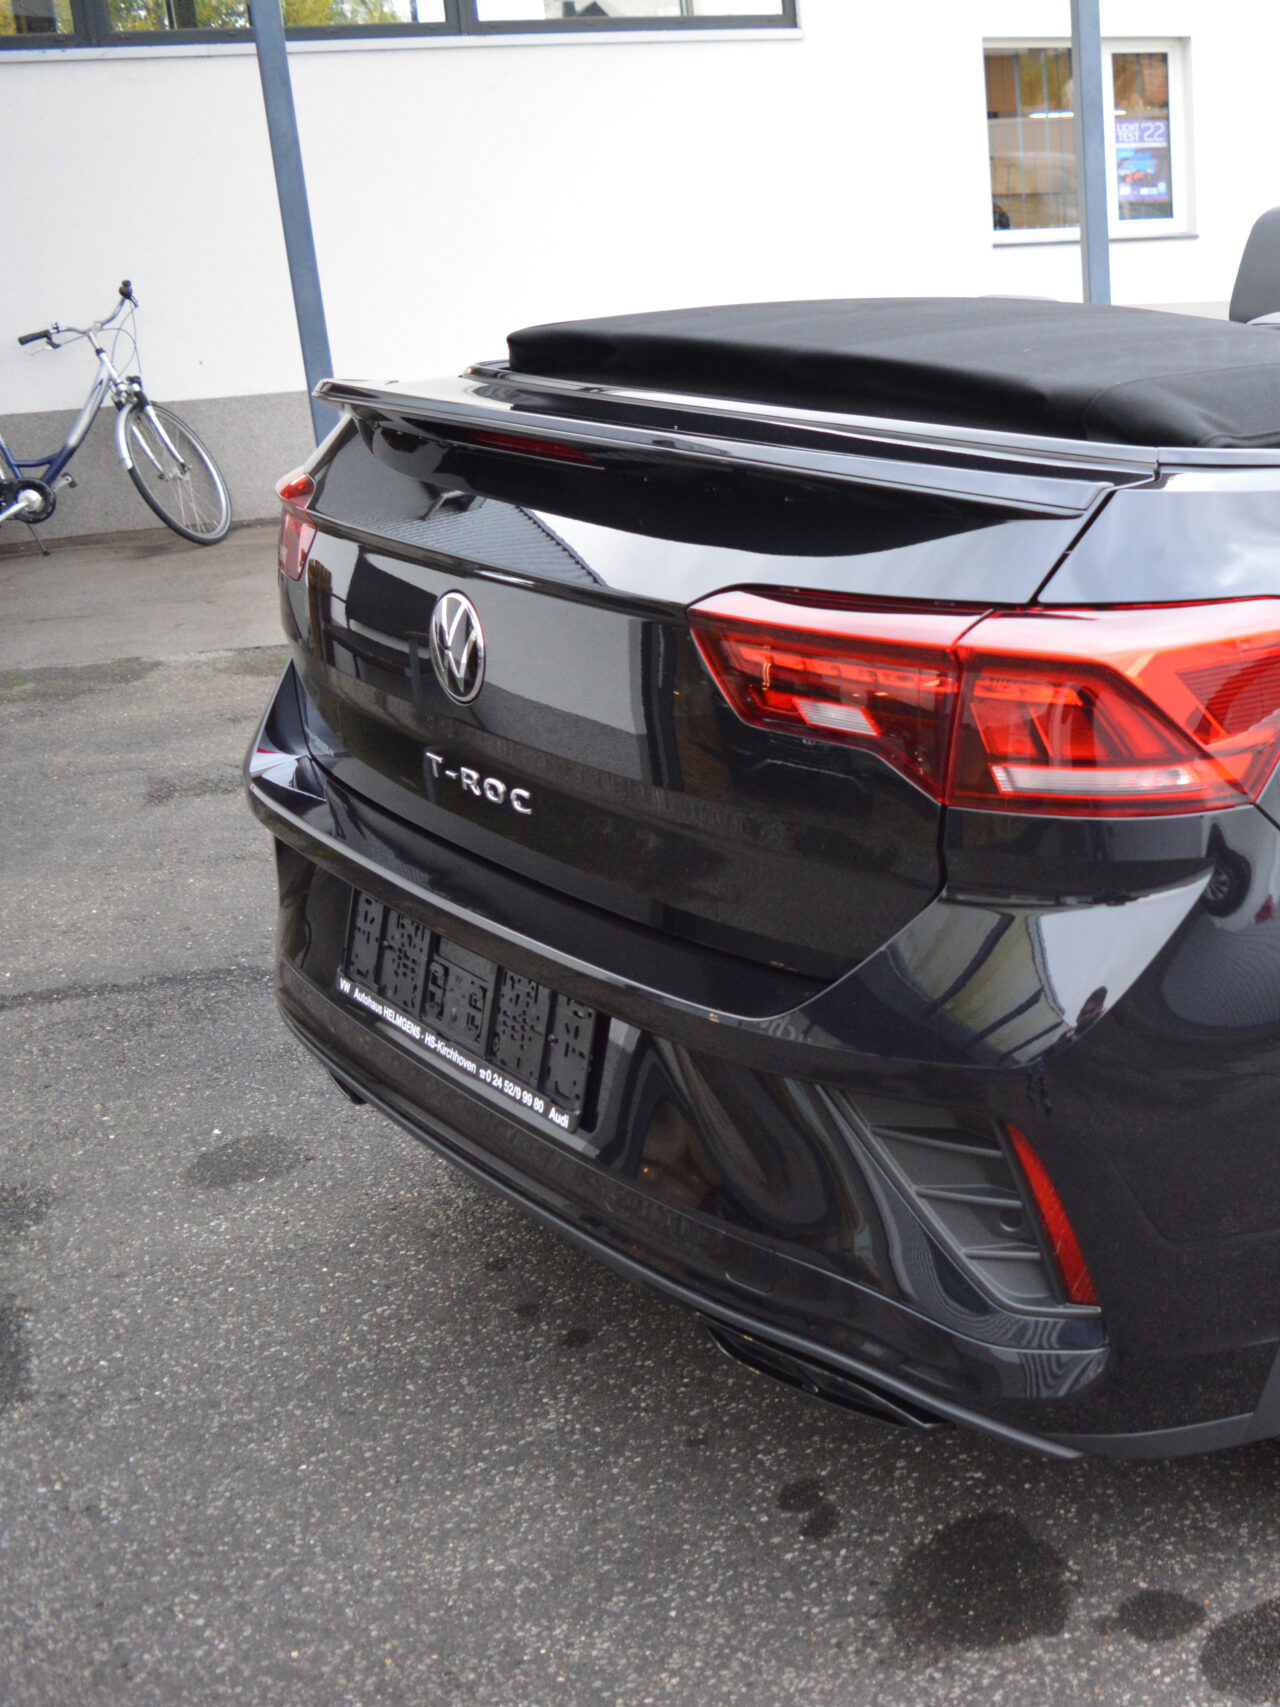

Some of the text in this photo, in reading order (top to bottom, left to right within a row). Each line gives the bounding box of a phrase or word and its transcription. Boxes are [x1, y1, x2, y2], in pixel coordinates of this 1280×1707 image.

[425, 751, 533, 815] T-ROC
[339, 977, 351, 994] VW
[353, 987, 383, 1015] Autohaus
[383, 1005, 421, 1039] HELMGENS
[423, 1032, 477, 1075] HS-Kirchhoven
[548, 1107, 570, 1129] Audi
